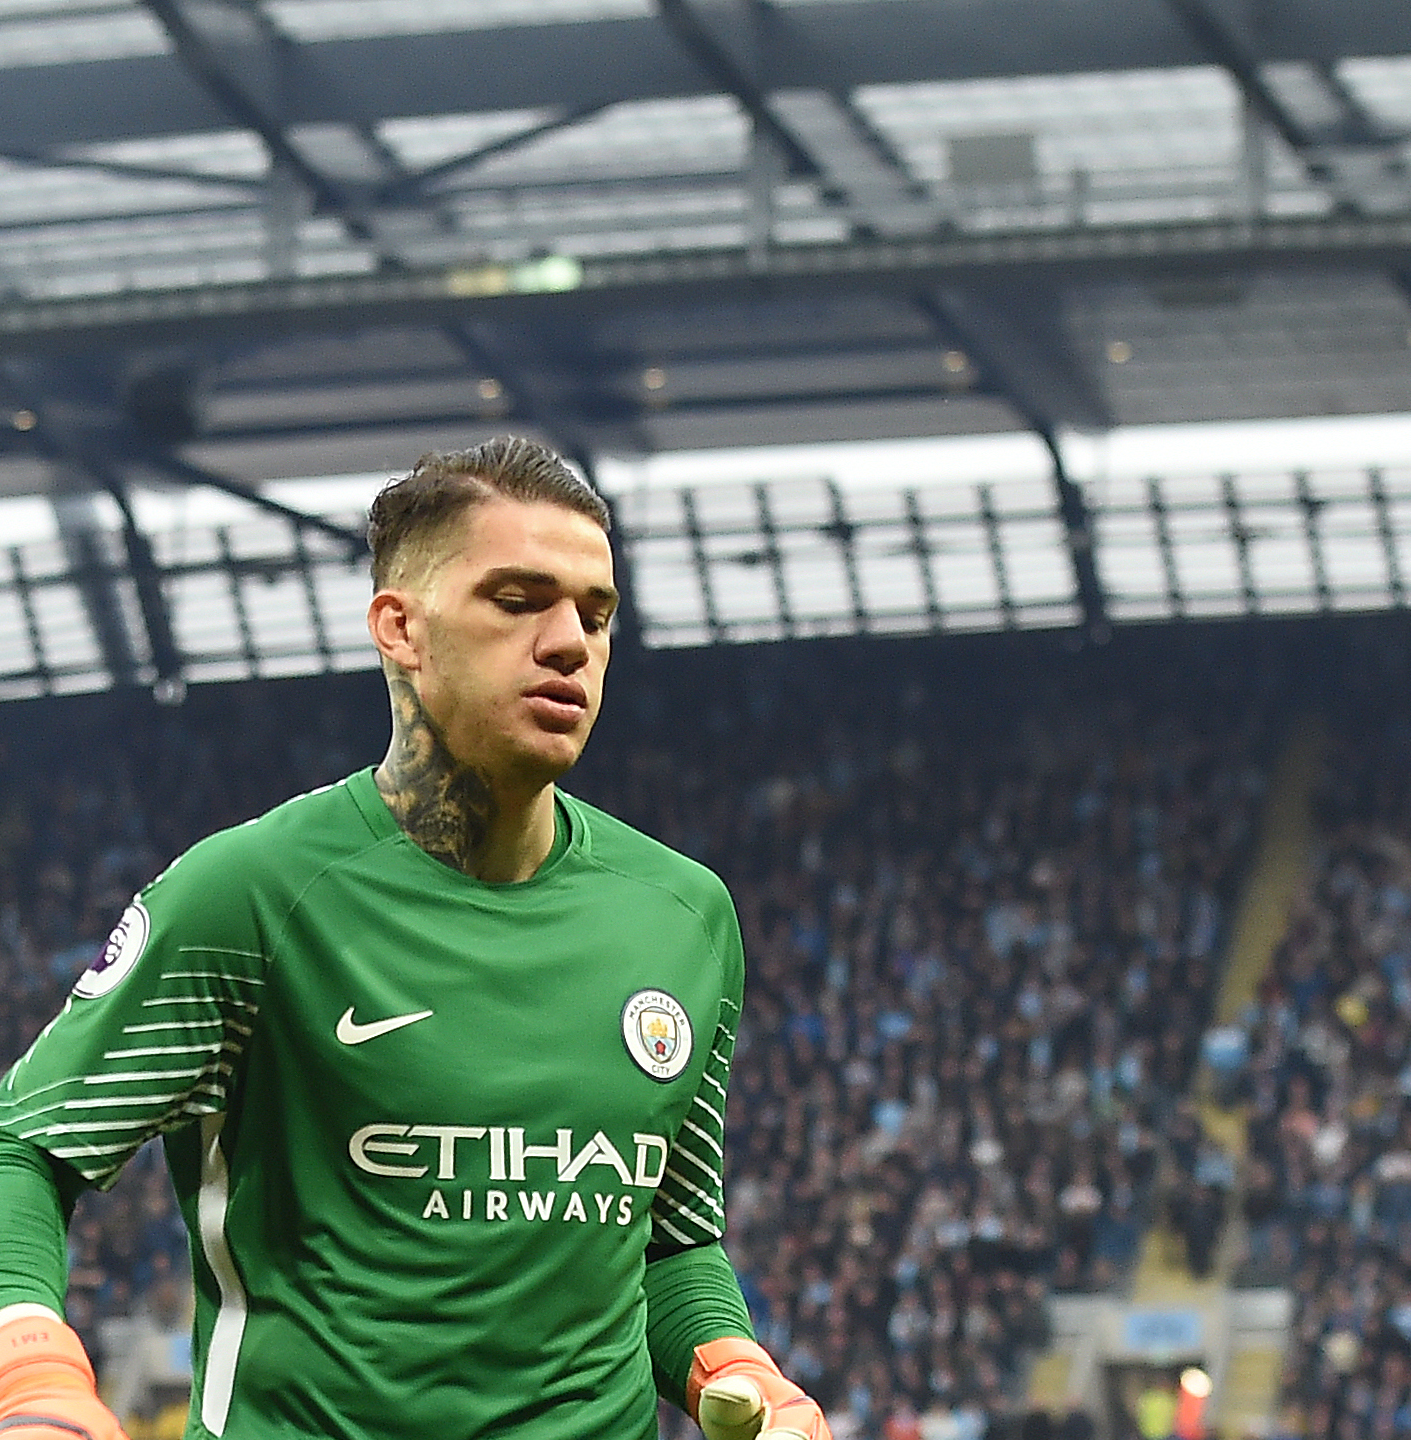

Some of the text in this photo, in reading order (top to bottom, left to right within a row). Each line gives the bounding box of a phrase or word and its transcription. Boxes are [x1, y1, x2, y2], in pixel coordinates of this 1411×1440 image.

[629, 996, 685, 1026] MANCHESTER
[651, 1064, 670, 1075] CITY
[348, 1122, 668, 1188] ETIHAD
[423, 1189, 633, 1226] AIRWAYS
